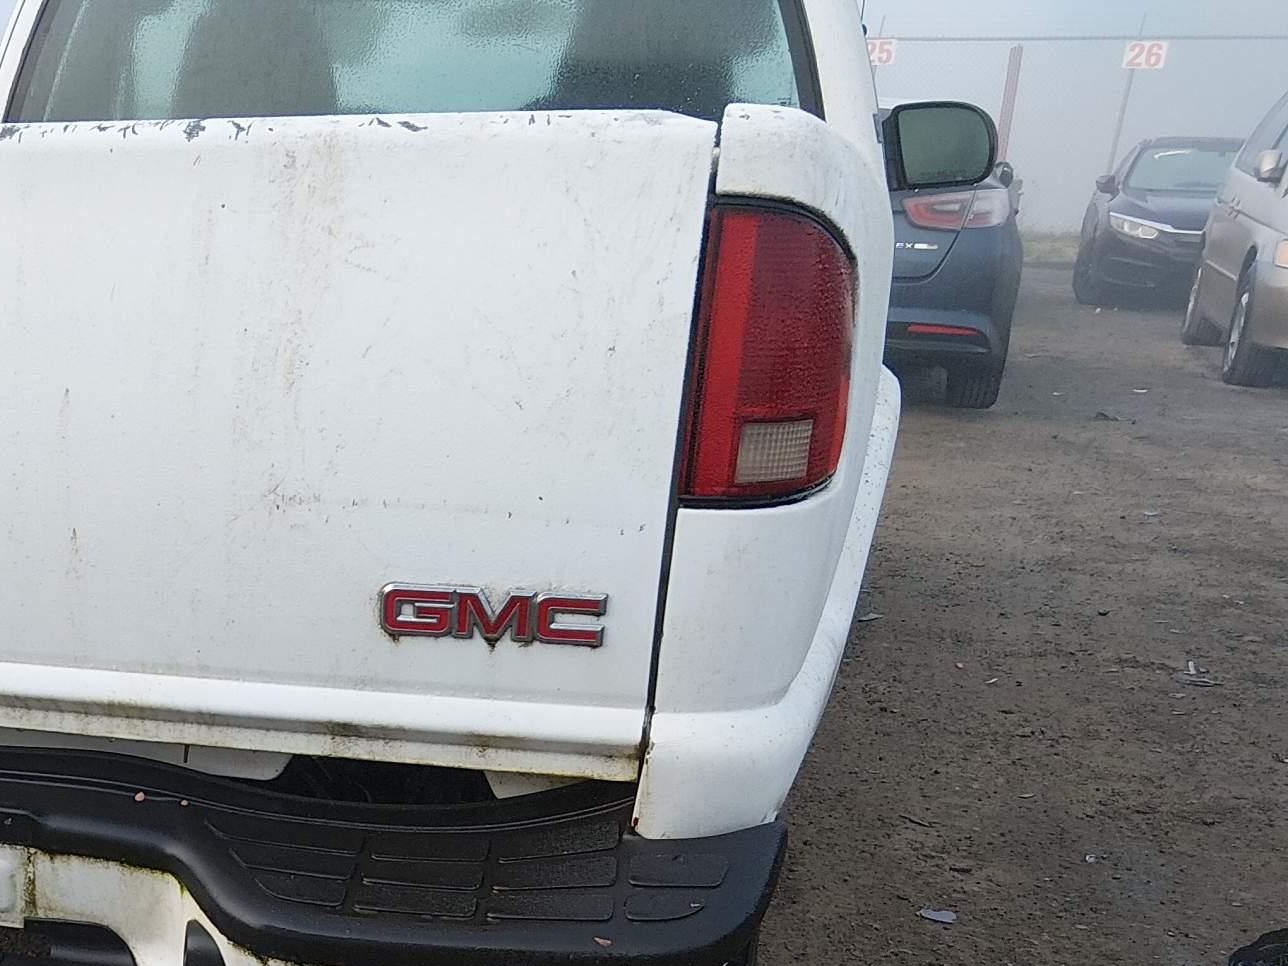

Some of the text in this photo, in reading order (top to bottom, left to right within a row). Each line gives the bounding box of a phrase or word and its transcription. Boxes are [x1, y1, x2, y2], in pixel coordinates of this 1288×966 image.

[867, 41, 893, 64] 25
[1127, 42, 1162, 67] 26
[380, 582, 609, 647] GMC
